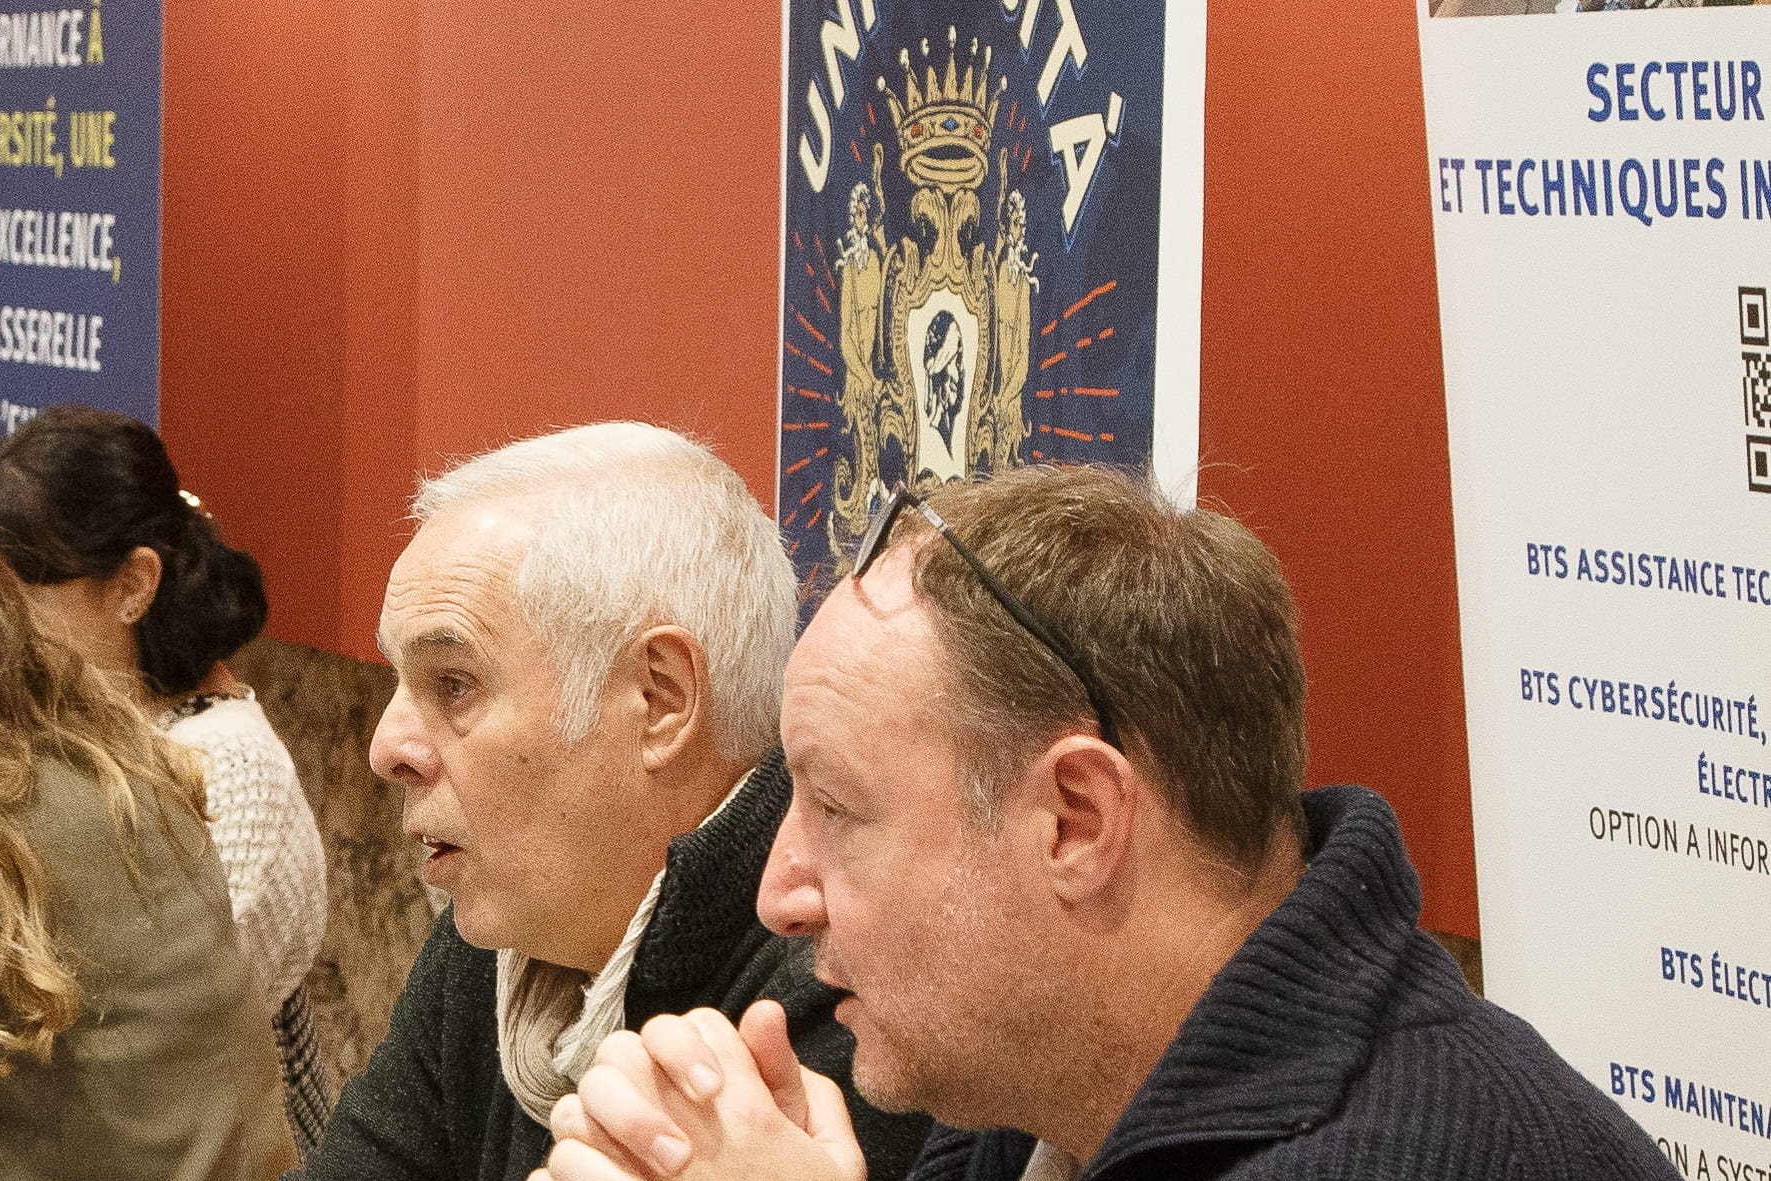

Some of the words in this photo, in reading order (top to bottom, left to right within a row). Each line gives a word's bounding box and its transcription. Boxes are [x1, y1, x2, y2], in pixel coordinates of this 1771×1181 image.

[1586, 60, 1765, 122] SECTEUR
[70, 111, 116, 169] UNE
[1438, 157, 1465, 213] ET
[1474, 156, 1727, 227] TECHNIQUES
[1527, 542, 1568, 579] BTS
[1577, 548, 1726, 598] ASSISTANCE
[1731, 566, 1771, 605] TEC
[1520, 668, 1561, 706] BTS
[1568, 675, 1767, 746] CYBERSÉCURITÉ,
[1697, 750, 1771, 808] ÉLECTR
[1589, 806, 1678, 854] OPTION
[1686, 823, 1701, 859] A
[1707, 827, 1771, 876] INFOR
[1660, 946, 1704, 988] BTS
[1711, 950, 1771, 1009] ÉLECT
[1610, 1061, 1656, 1103] BTS
